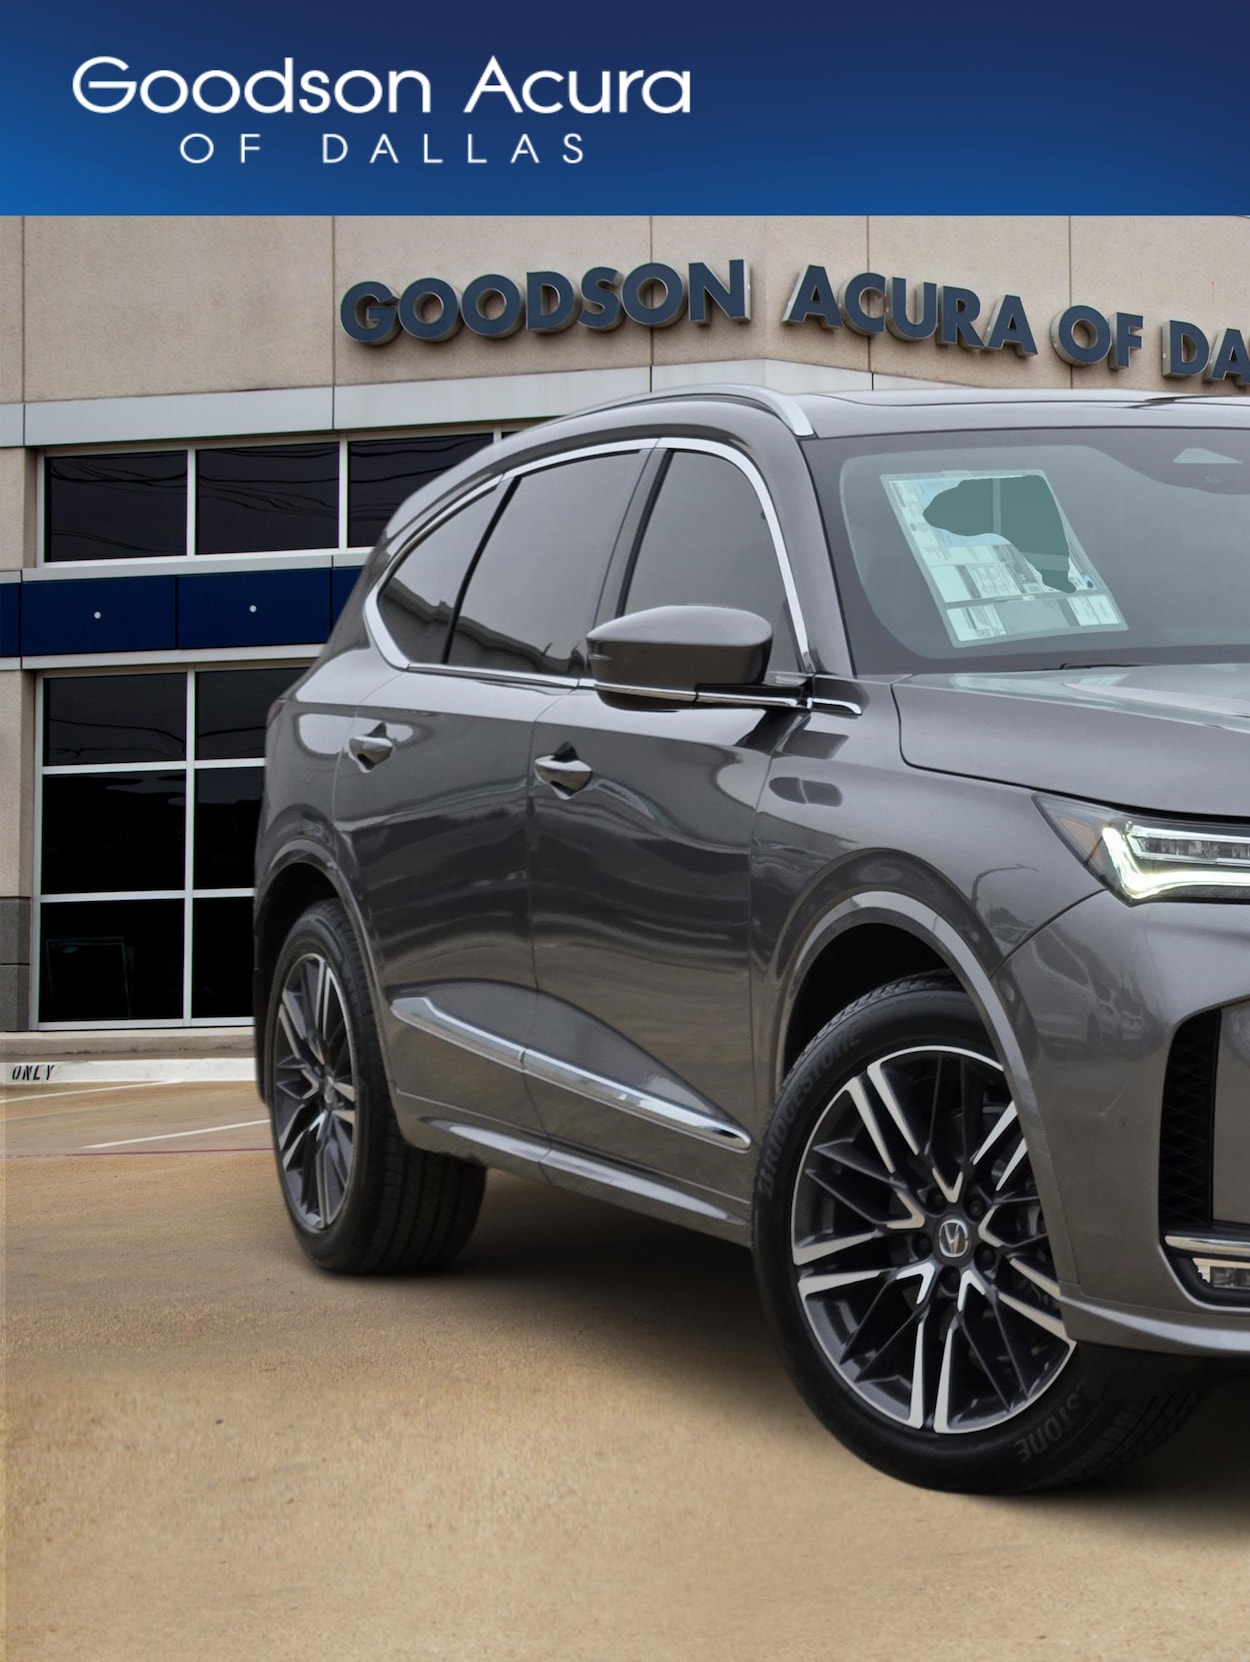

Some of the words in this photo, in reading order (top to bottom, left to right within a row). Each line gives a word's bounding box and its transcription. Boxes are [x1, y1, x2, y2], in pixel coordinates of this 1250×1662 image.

[340, 258, 751, 350] GOODSON
[782, 263, 1039, 359] ACURA
[1050, 304, 1144, 371] OF
[11, 1063, 55, 1081] ONLY
